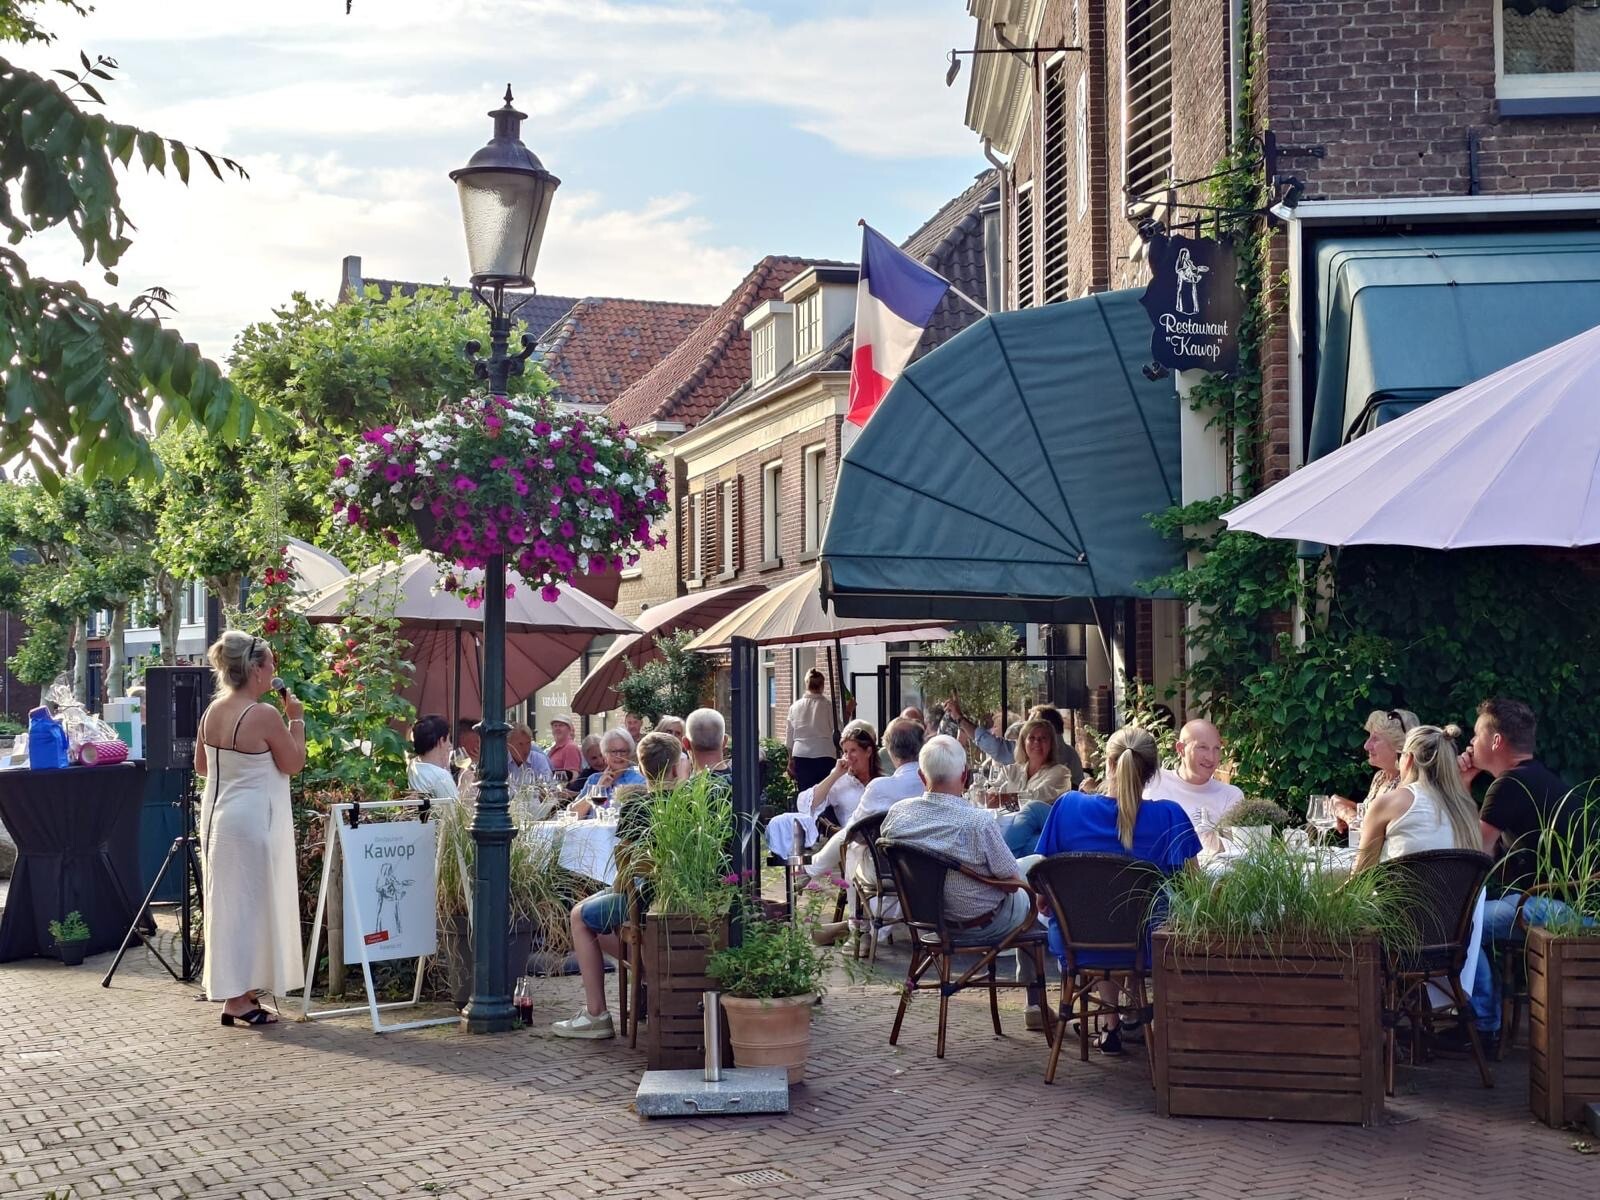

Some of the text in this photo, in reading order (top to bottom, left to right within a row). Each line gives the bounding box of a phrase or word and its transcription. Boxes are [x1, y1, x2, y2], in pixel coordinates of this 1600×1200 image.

[1159, 313, 1229, 336] Restaurant
[1165, 335, 1223, 362] "Kawop"
[364, 843, 415, 860] Kawop
